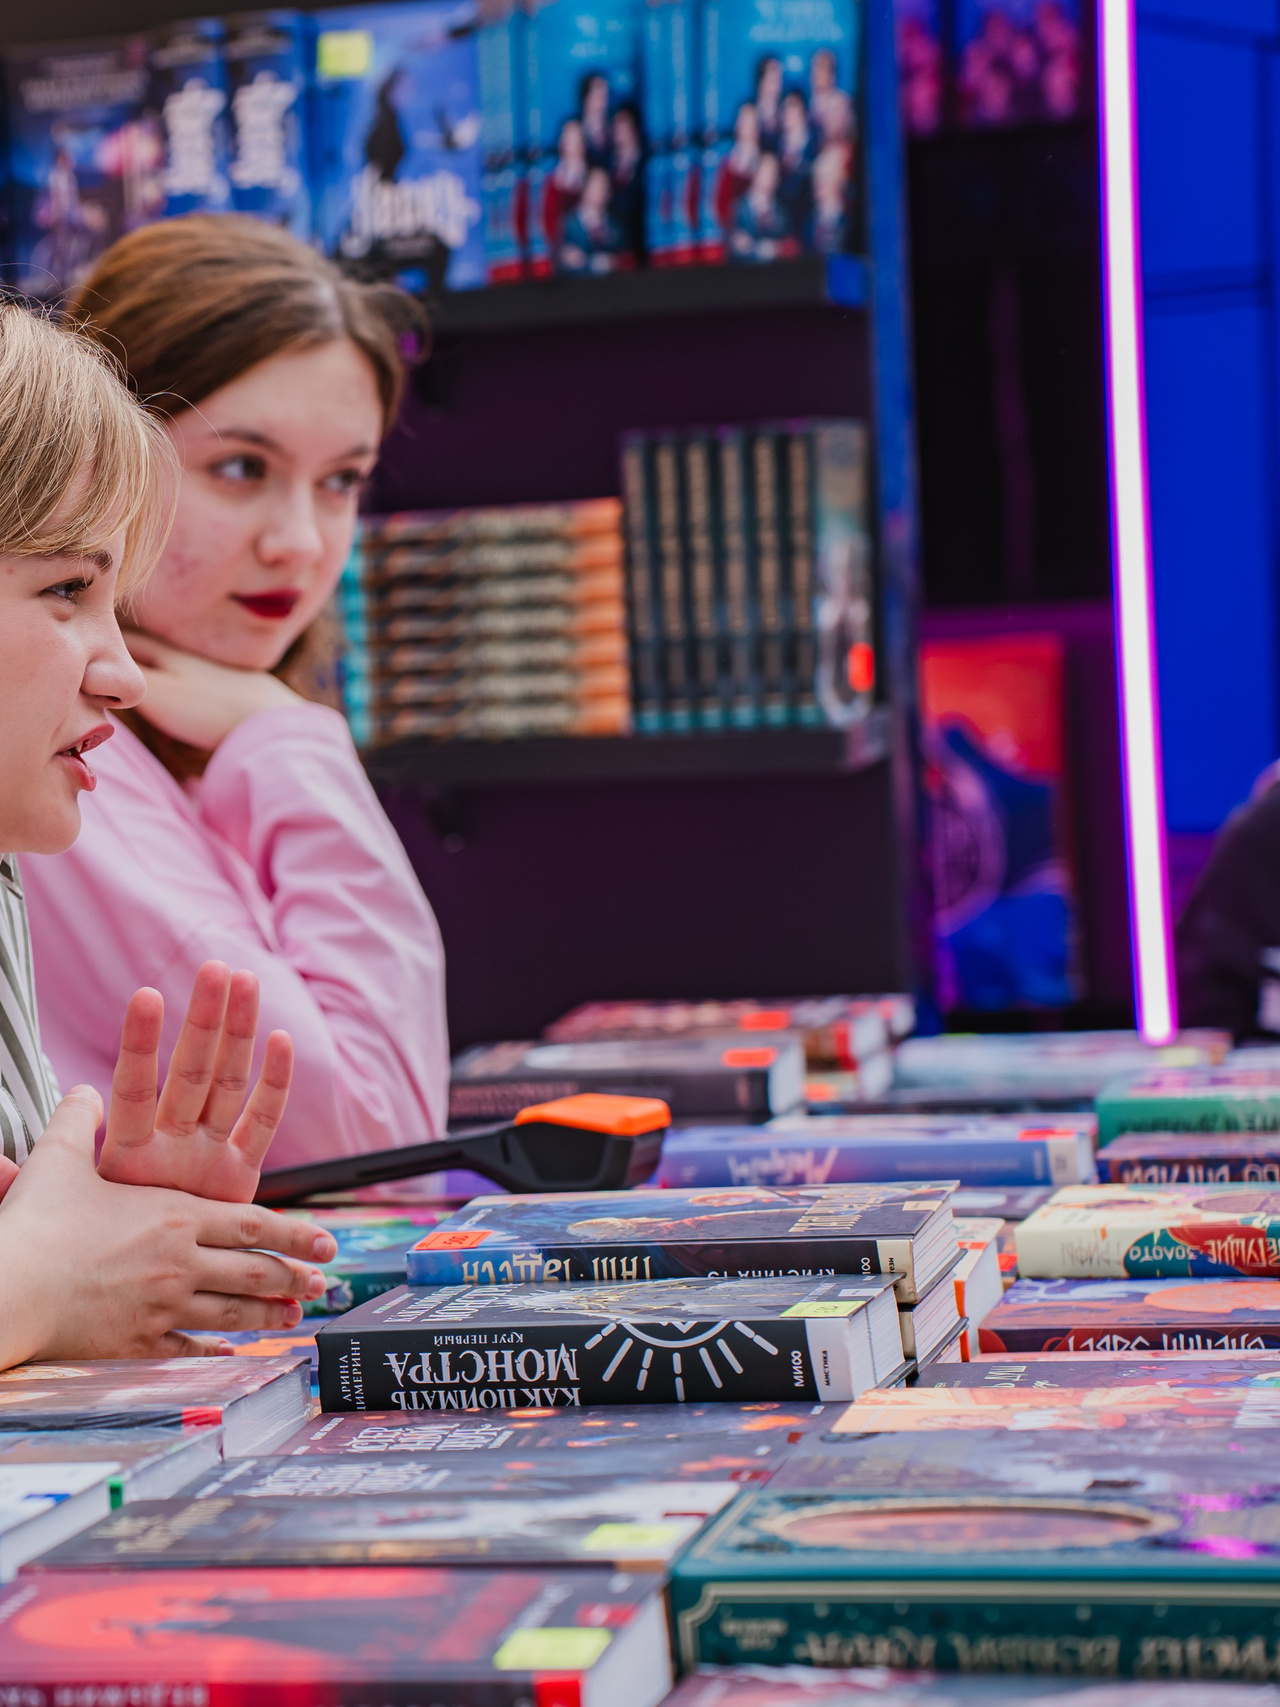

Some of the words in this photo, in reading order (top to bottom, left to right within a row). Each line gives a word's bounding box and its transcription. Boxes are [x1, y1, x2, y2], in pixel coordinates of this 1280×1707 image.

[1129, 1245, 1197, 1263] ЗОЛОТО
[433, 1334, 488, 1348] ПЕРВЫЙ
[491, 1331, 524, 1344] КРУГ
[383, 1343, 581, 1387] МОНСТРА
[338, 1355, 352, 1402] АРИНА
[519, 1387, 581, 1407] КАК
